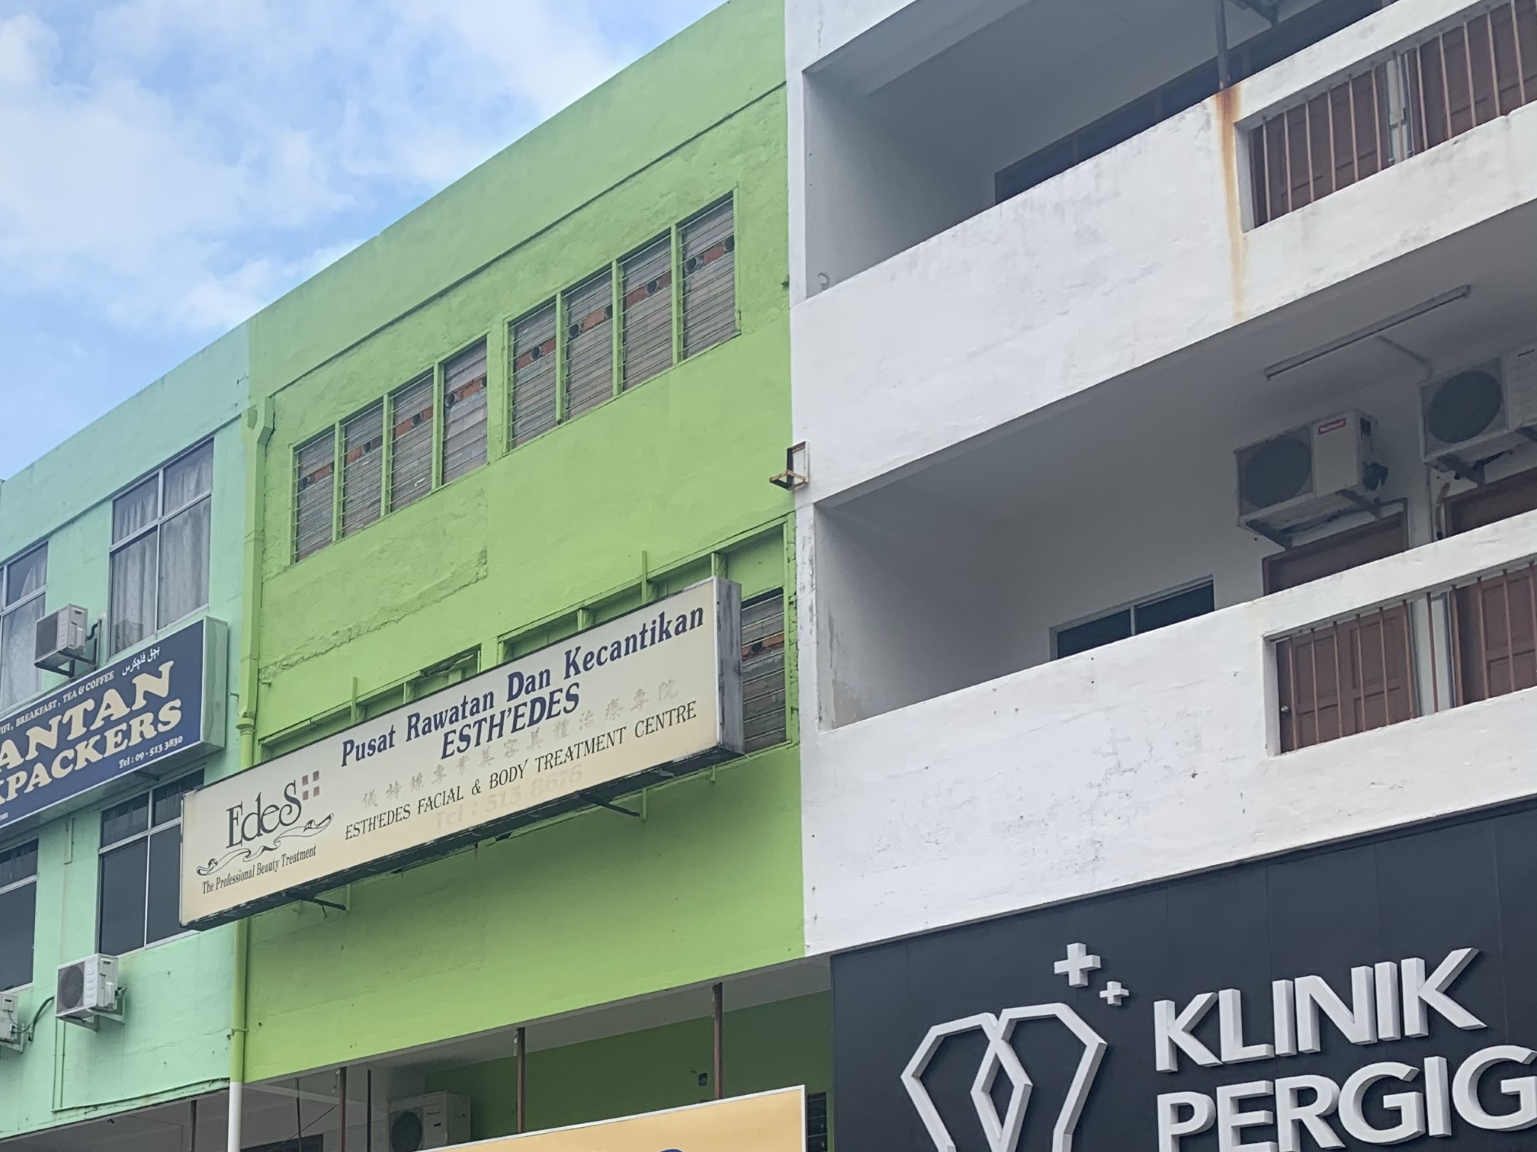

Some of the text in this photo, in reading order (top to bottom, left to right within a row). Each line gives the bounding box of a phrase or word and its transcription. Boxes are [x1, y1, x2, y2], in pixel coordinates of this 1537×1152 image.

[63, 691, 77, 703] TEA
[78, 685, 85, 695] &
[85, 671, 115, 692] COFFEE
[341, 606, 704, 767] Pusat Rawatan Dan Kecantikan
[118, 758, 130, 769] Tel
[417, 785, 464, 815] FACIAL
[471, 778, 482, 796] &
[489, 758, 530, 790] BODY
[534, 726, 627, 773] TREATMENT
[634, 700, 697, 738] CENTRE
[202, 844, 317, 895] The Professional Beauty Treatment
[1153, 947, 1488, 1073] KLINIK
